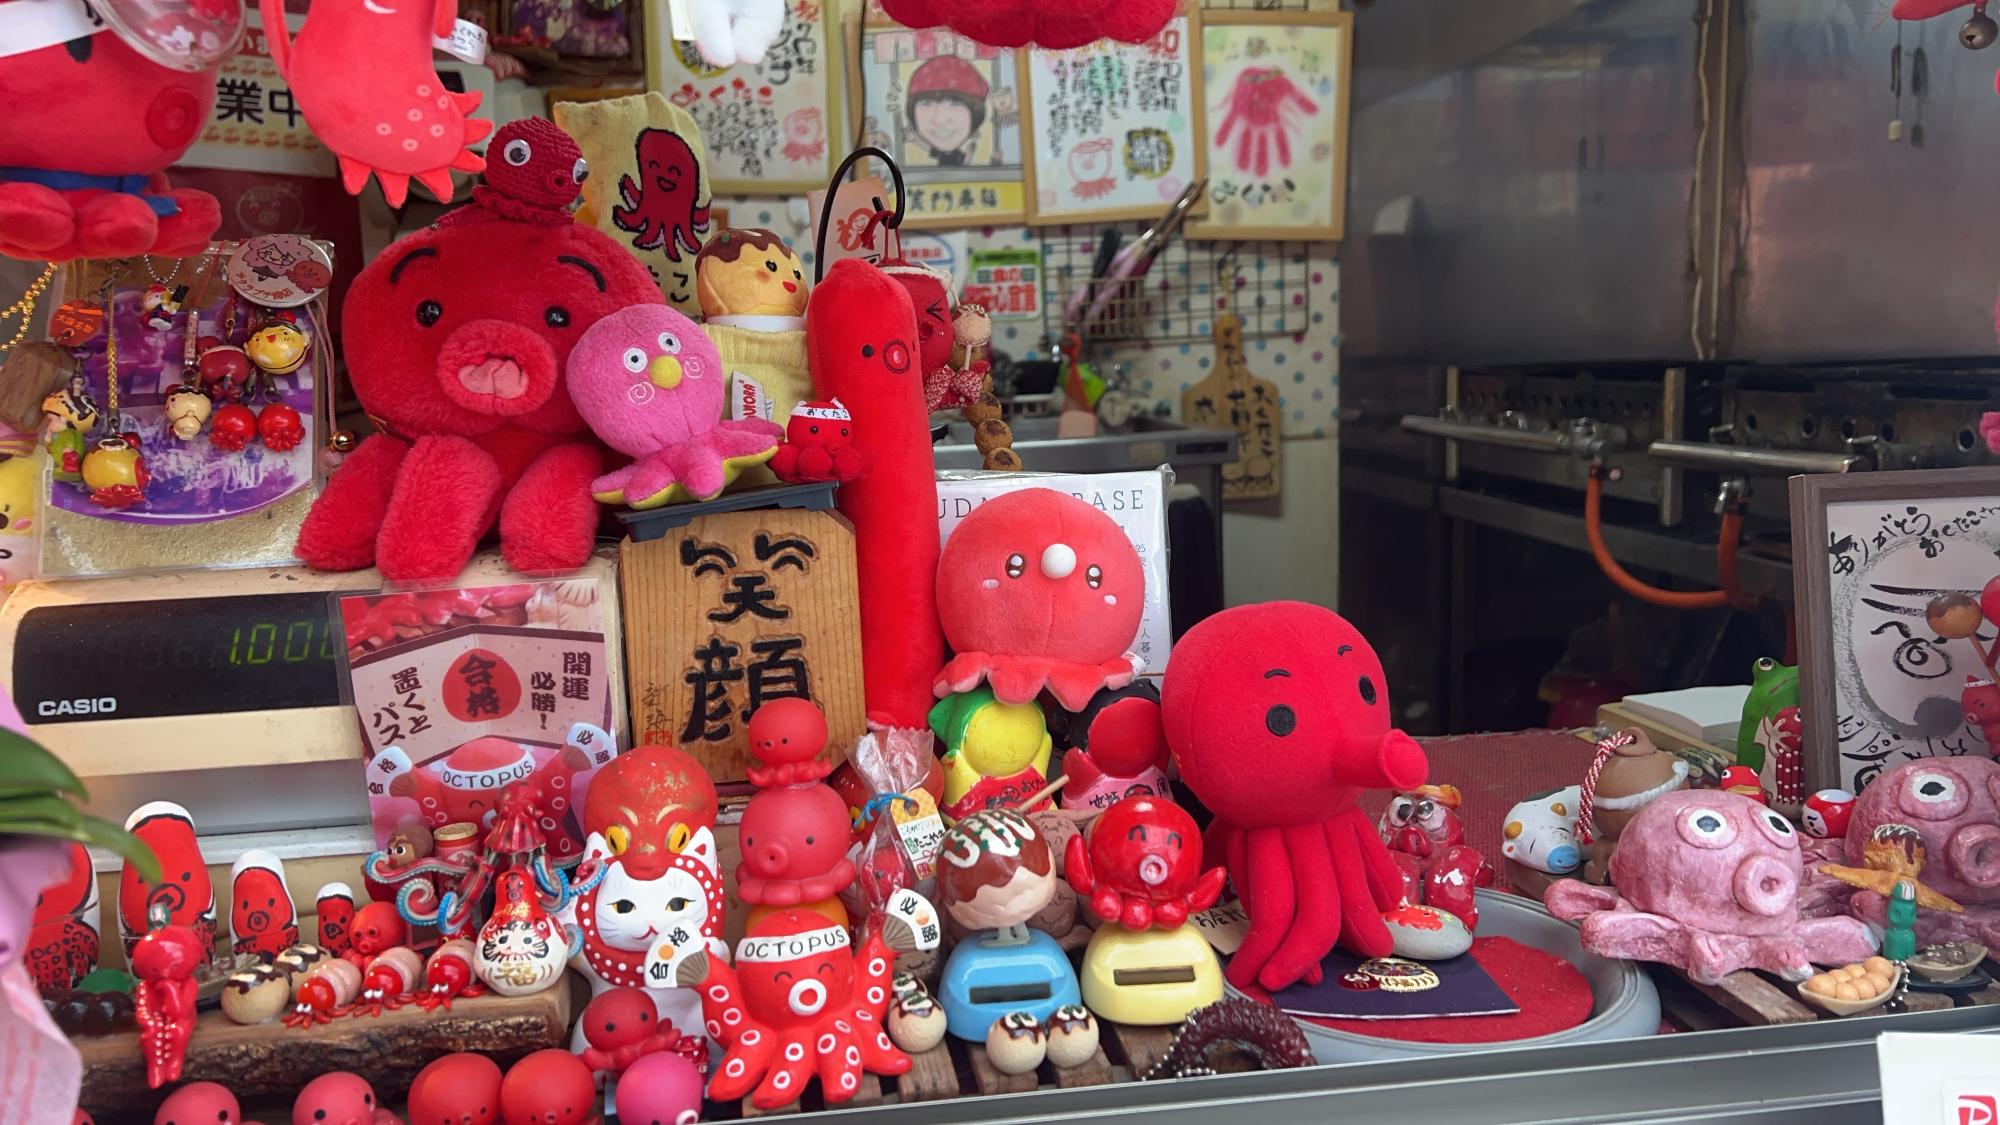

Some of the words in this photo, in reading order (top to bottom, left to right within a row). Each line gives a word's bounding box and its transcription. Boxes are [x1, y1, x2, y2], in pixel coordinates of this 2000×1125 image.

[680, 533, 815, 743] 笑顔
[459, 654, 499, 718] 合格
[562, 651, 592, 701] 開運
[38, 697, 117, 716] CASIO
[373, 701, 406, 746] パス
[391, 666, 432, 735] 置くと
[443, 760, 534, 789] OCTOPUS
[744, 930, 846, 959] OCTOPUS
